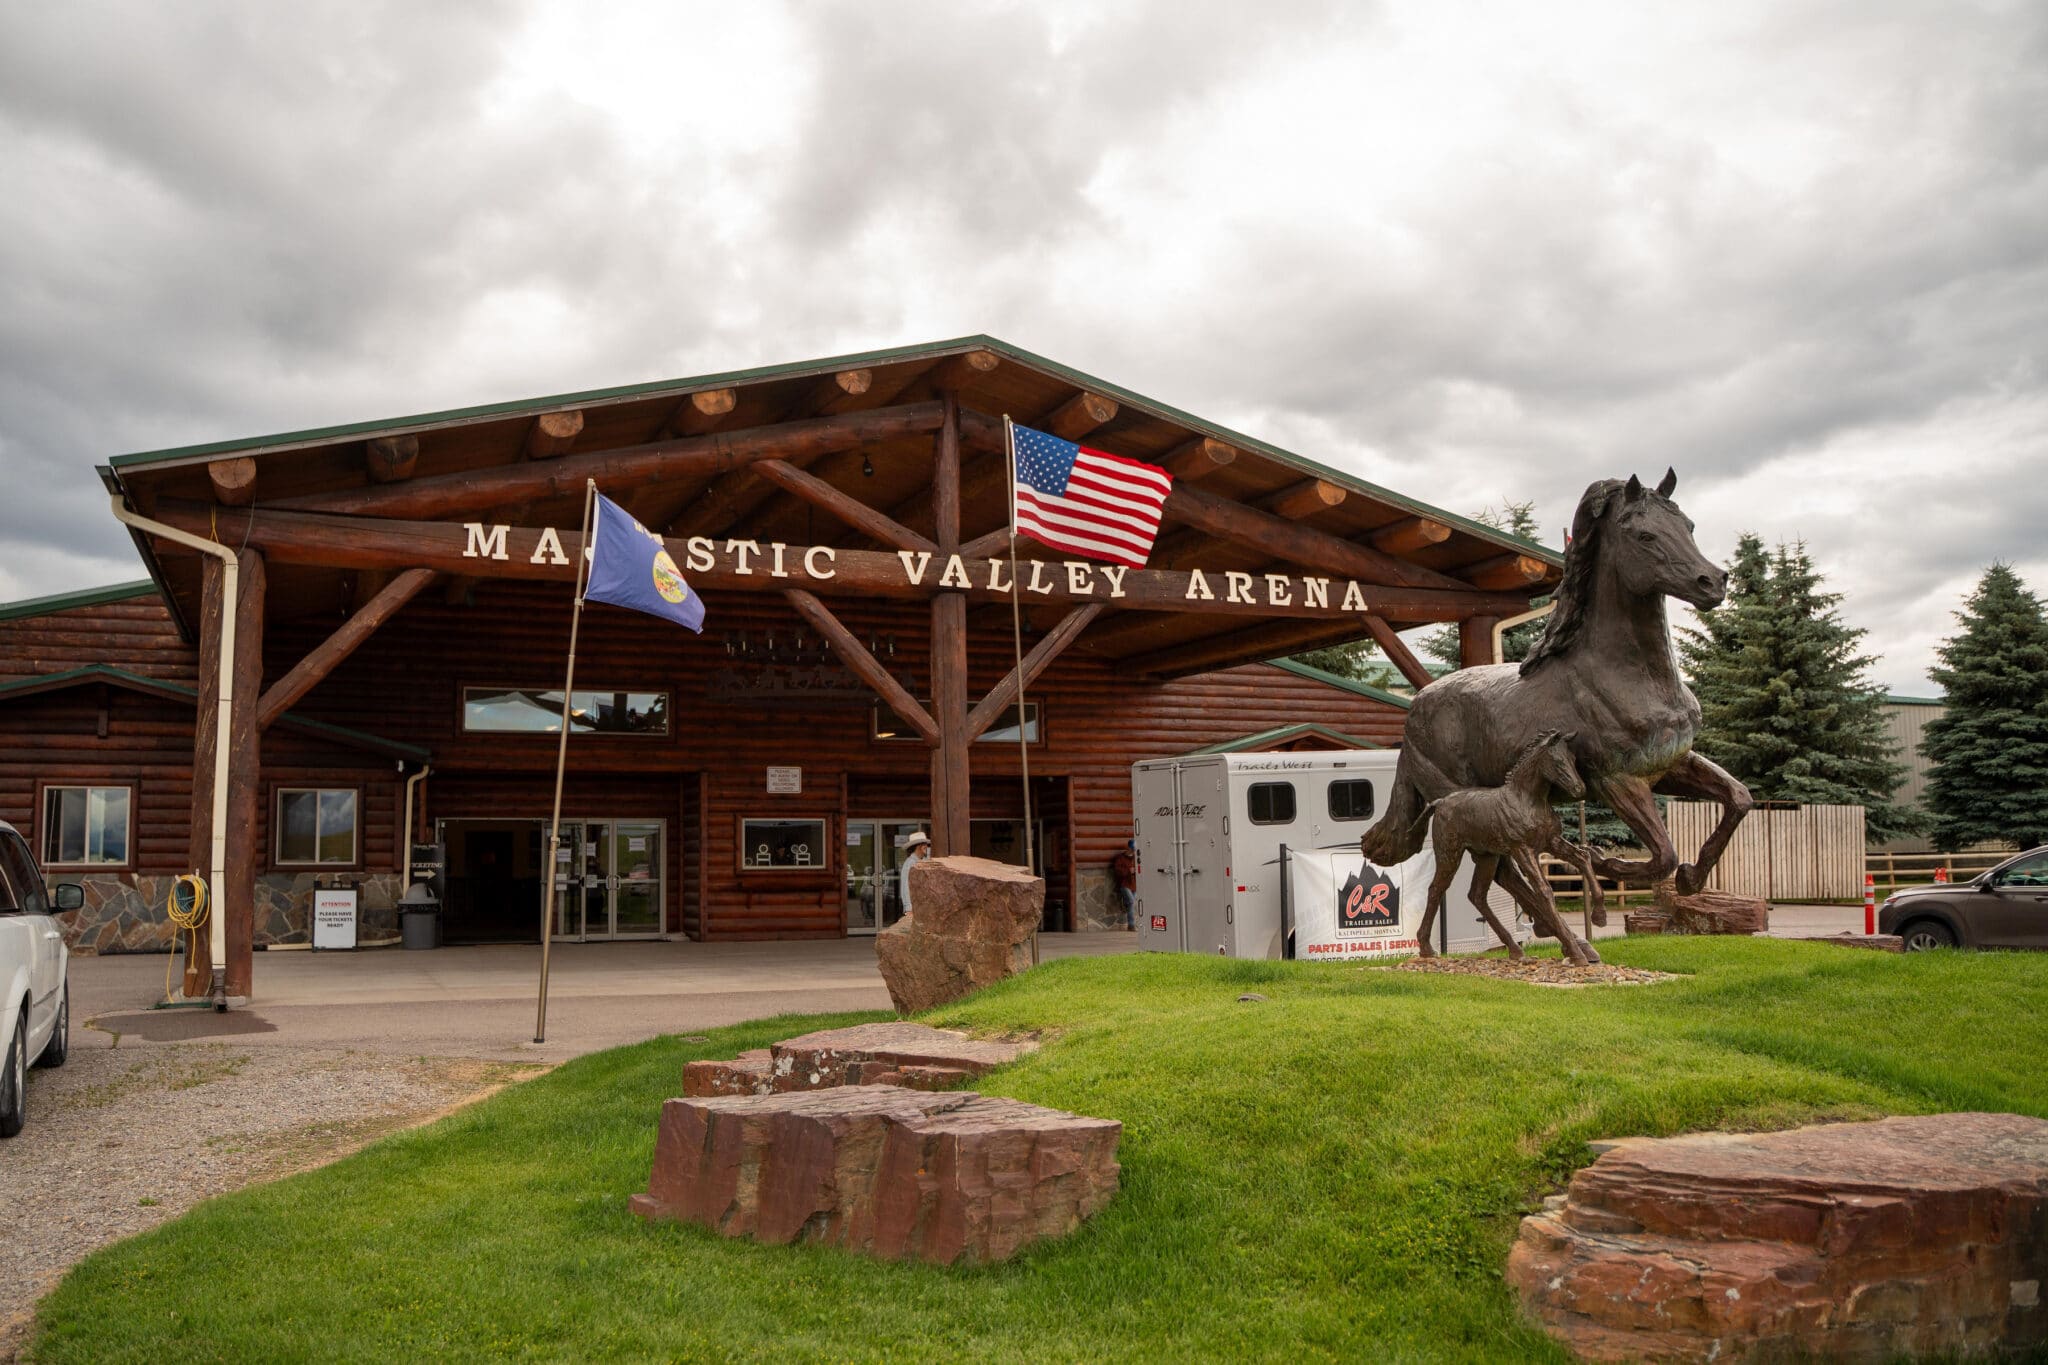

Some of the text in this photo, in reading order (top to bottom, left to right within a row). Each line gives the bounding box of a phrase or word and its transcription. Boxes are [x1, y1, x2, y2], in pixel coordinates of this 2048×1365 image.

[463, 522, 836, 579] MASTIC
[898, 551, 1129, 598] VALLEY
[1185, 569, 1368, 611] ARENA
[1234, 760, 1312, 771] Trails West
[1346, 883, 1390, 918] C&R
[1344, 919, 1374, 927] TRAILER
[1308, 943, 1342, 954] PARTS
[1350, 941, 1382, 952] SALES
